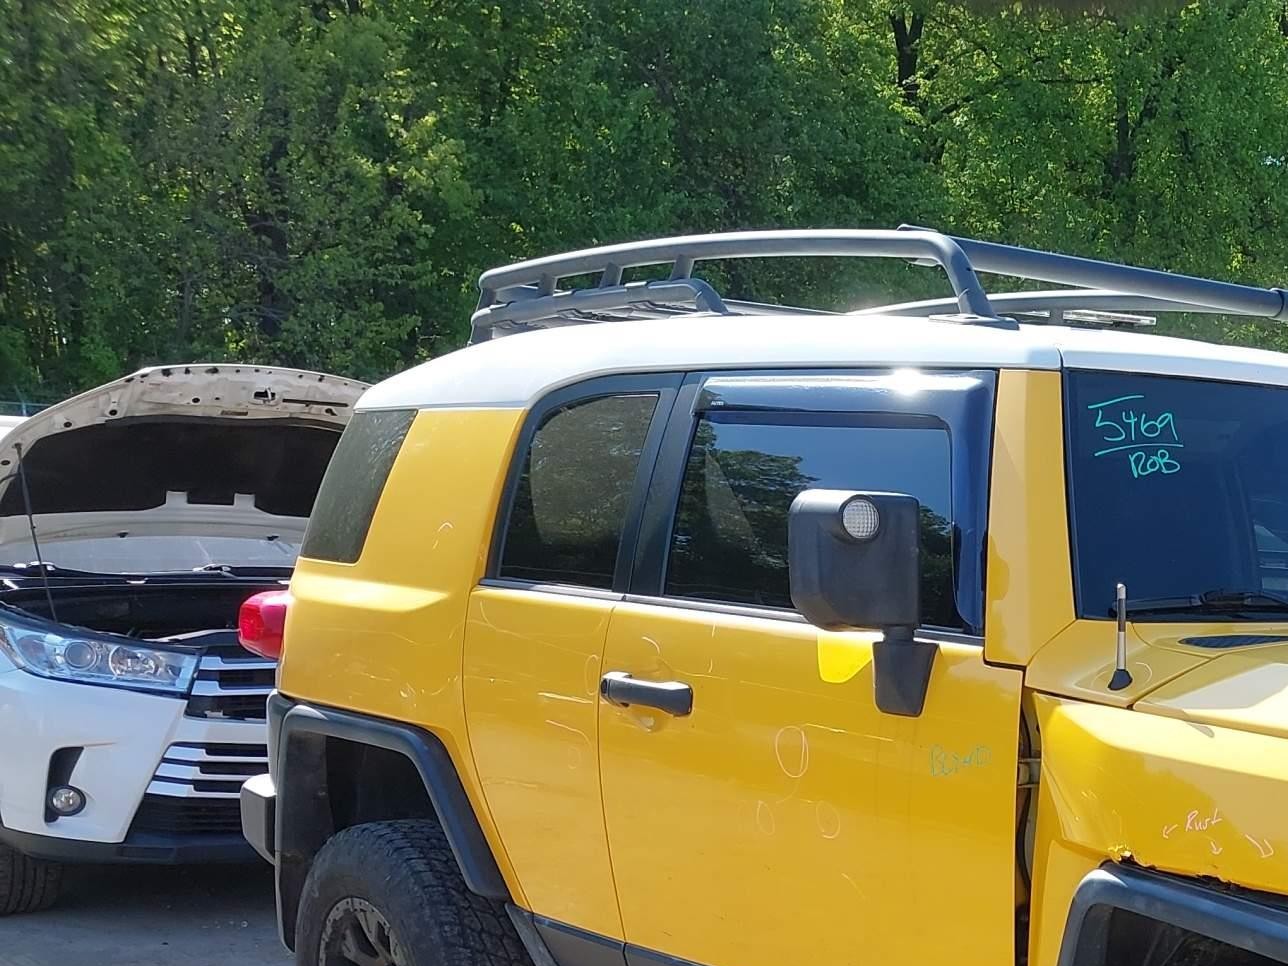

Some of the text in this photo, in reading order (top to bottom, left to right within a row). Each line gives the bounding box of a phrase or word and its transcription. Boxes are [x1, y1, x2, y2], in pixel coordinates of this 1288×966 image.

[1087, 394, 1178, 442] 5469
[1128, 449, 1181, 479] ROB
[1185, 807, 1223, 832] Rust
